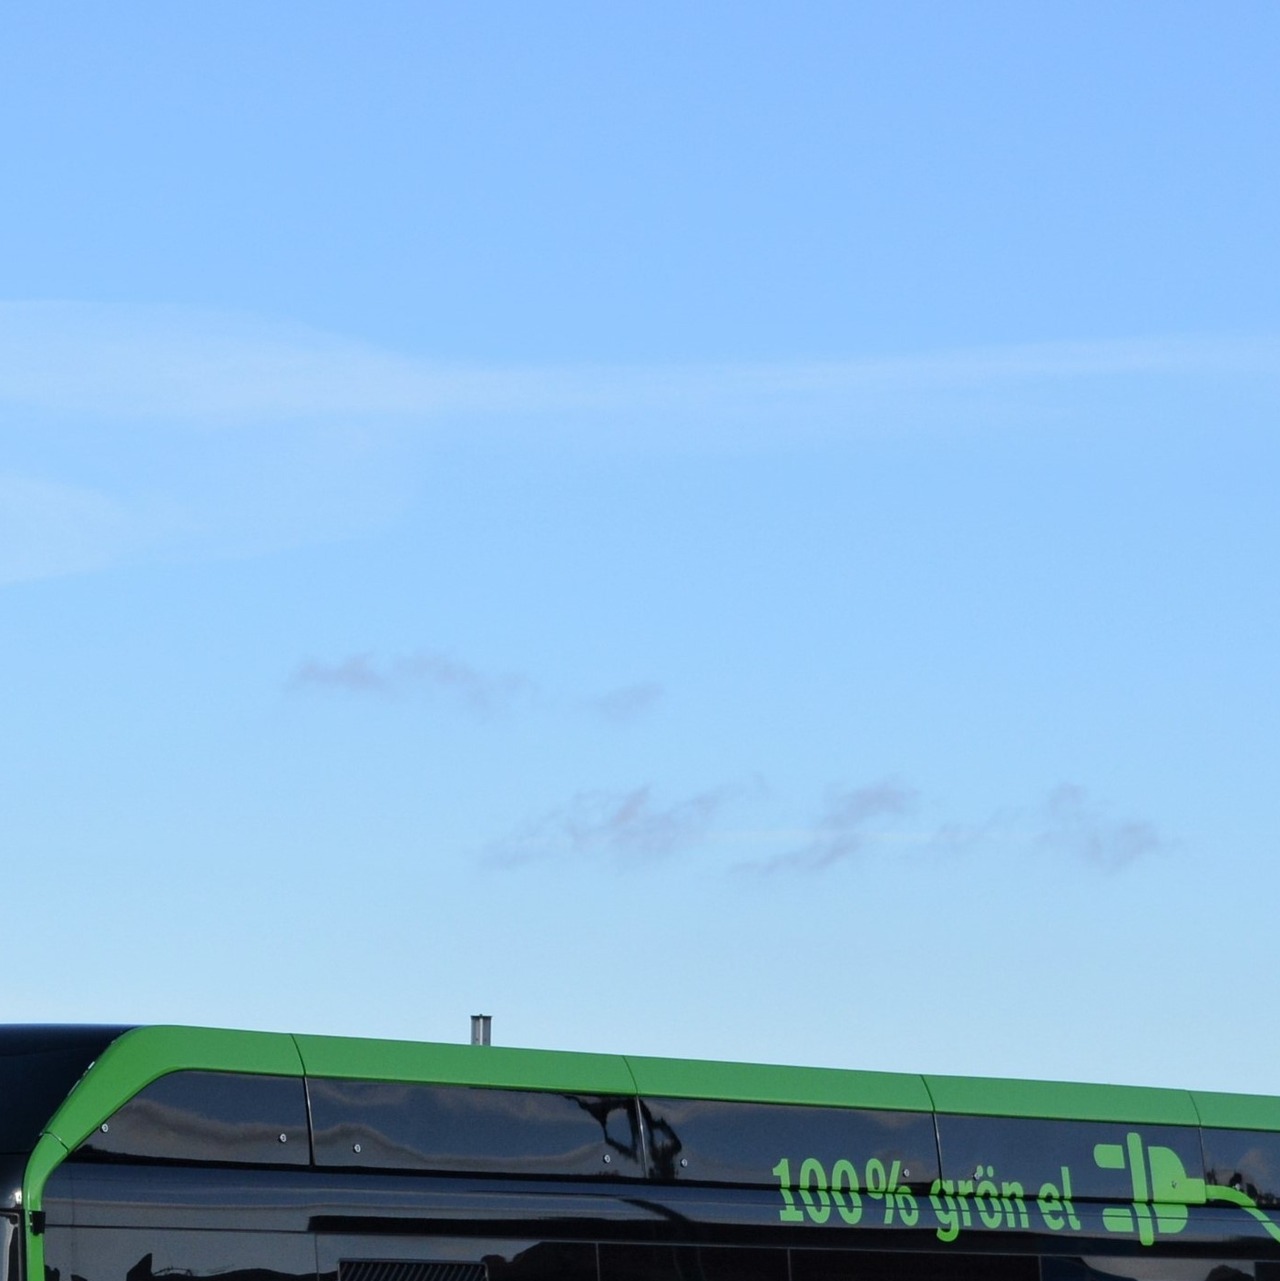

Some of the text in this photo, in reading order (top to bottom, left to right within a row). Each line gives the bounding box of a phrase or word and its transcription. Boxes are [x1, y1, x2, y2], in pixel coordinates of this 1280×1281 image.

[772, 1158, 1081, 1242] 100% grön el
